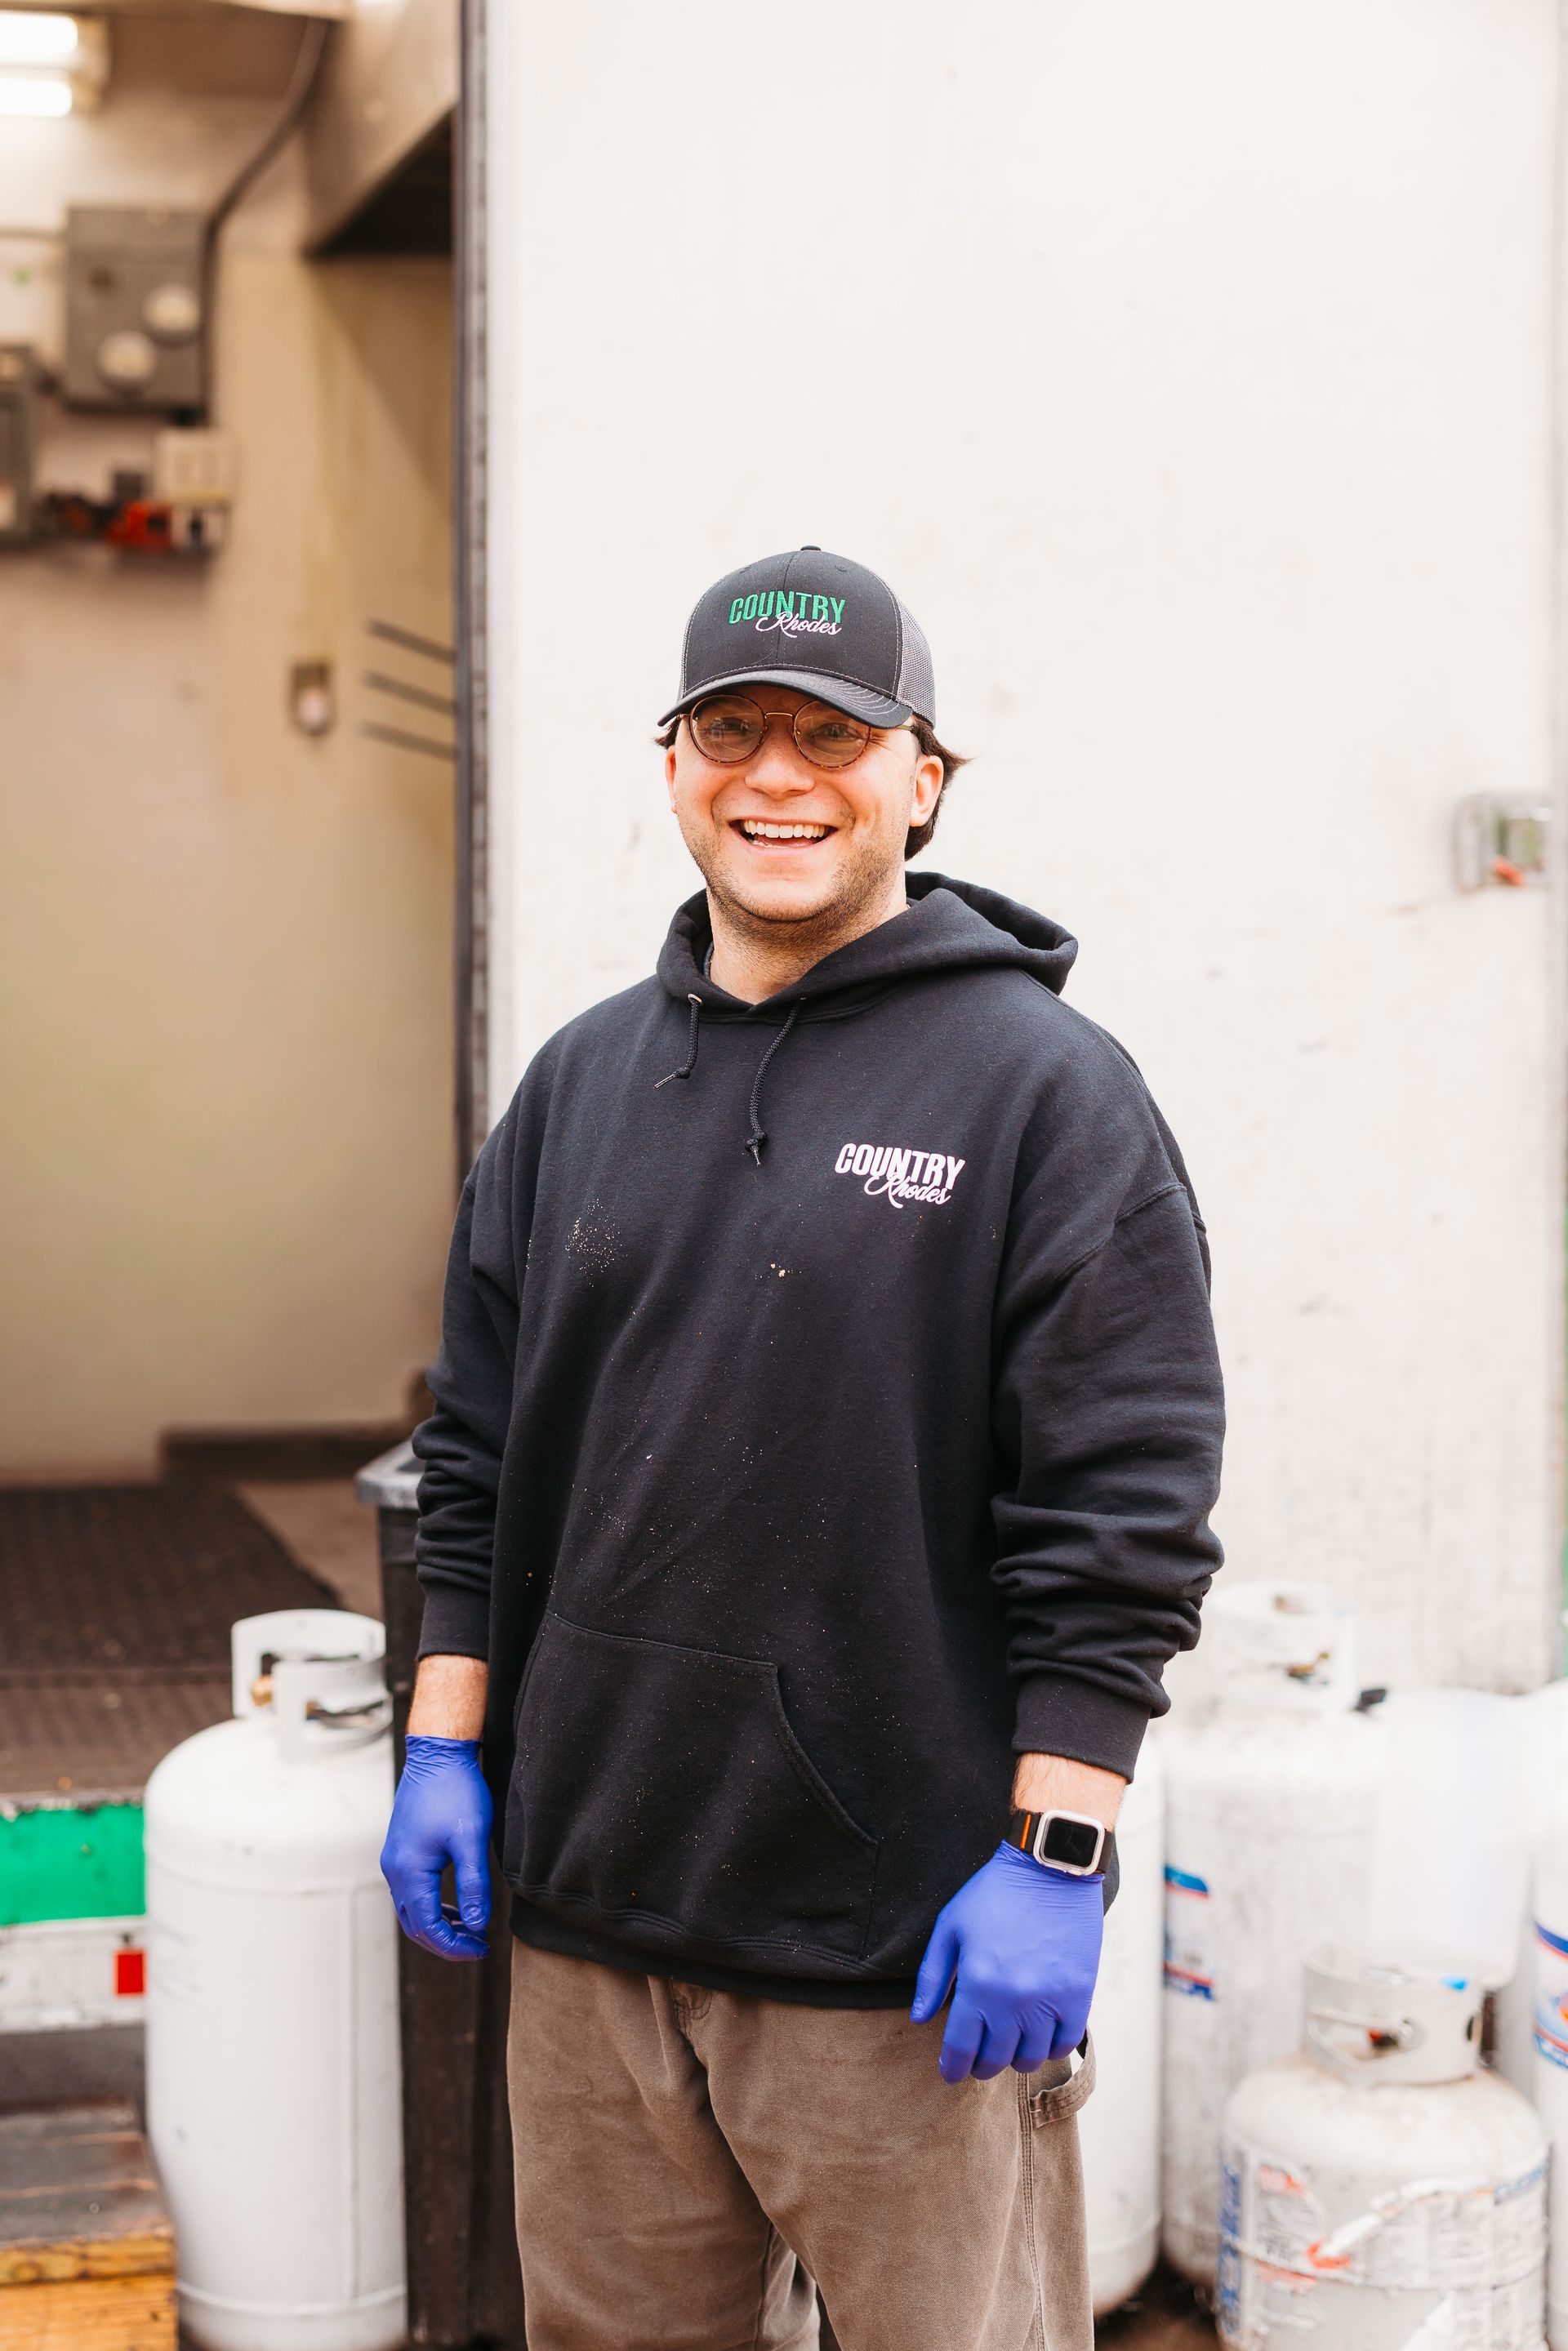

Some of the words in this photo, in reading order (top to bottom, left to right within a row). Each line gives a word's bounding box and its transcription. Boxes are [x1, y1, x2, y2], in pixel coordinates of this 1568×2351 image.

[728, 590, 846, 625] COUNTRY
[755, 611, 842, 638] Rhodes
[835, 1143, 965, 1190] COUNTRY
[864, 1174, 951, 1209] Rhodes
